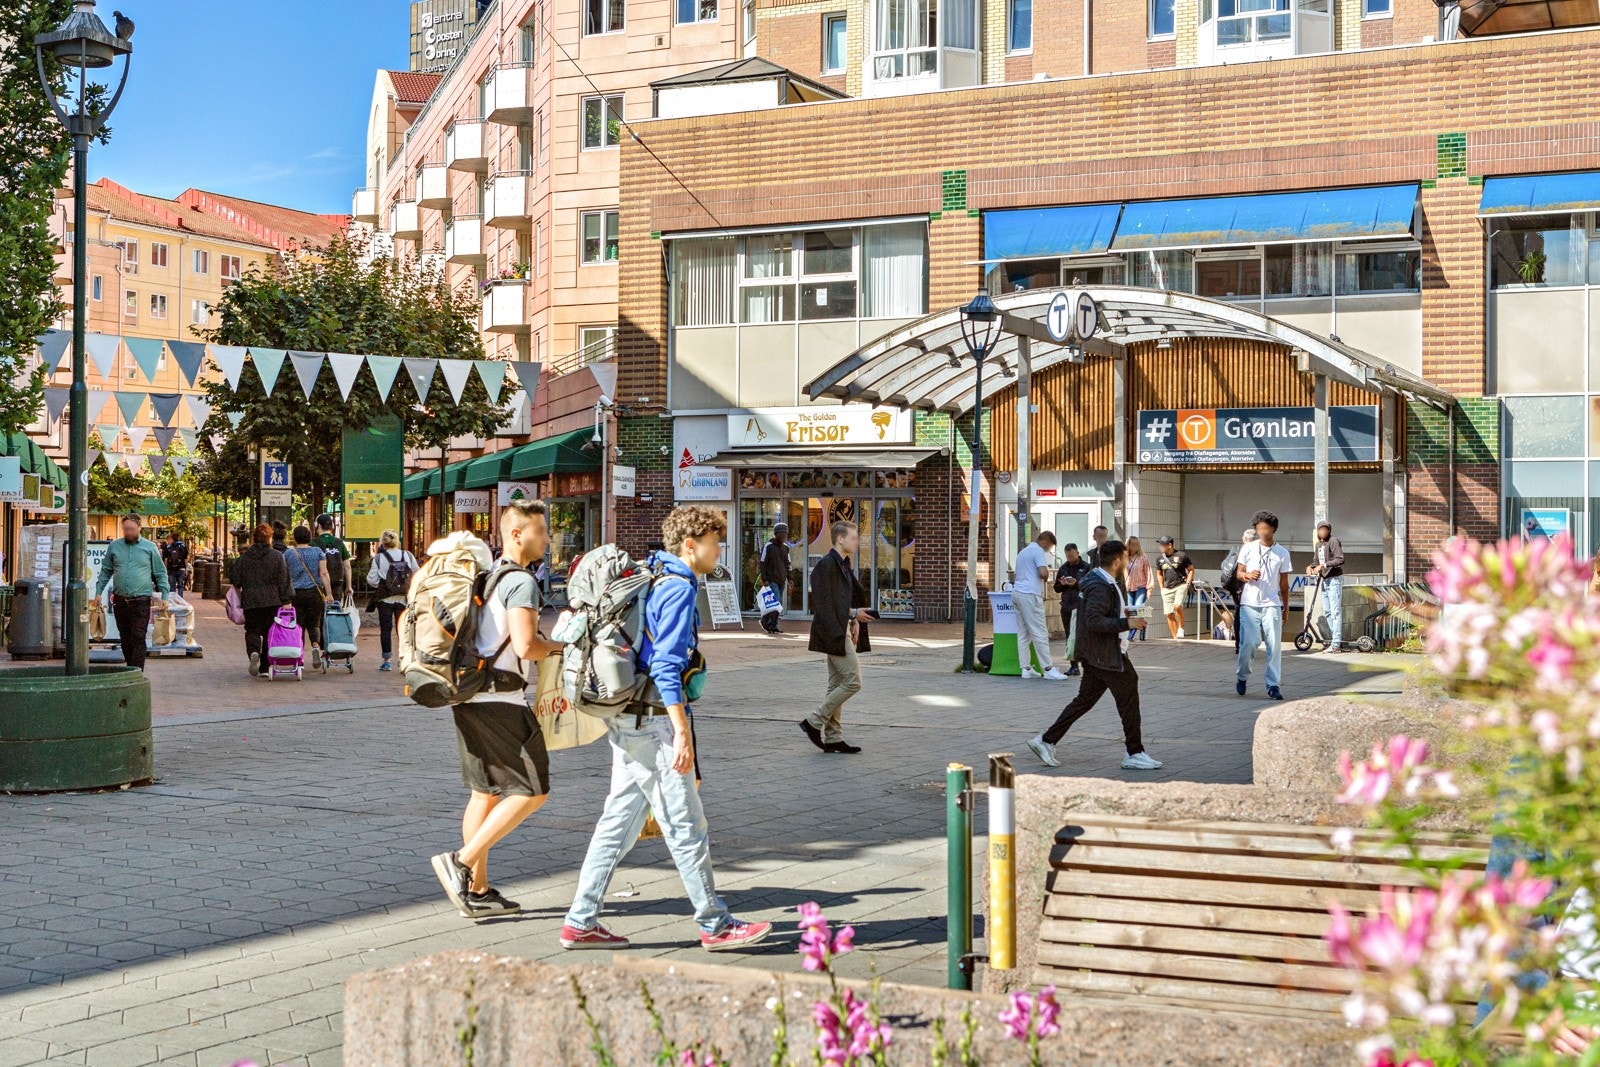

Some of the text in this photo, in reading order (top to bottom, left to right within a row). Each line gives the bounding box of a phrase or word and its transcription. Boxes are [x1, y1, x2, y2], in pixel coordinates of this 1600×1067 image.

[433, 11, 463, 24] entra
[436, 30, 463, 44] posten
[436, 47, 457, 58] bring
[1054, 304, 1066, 334] T
[1080, 304, 1092, 334] T
[798, 413, 837, 422] The Golden
[786, 421, 849, 442] Frisør
[1224, 417, 1332, 438] Grønlan
